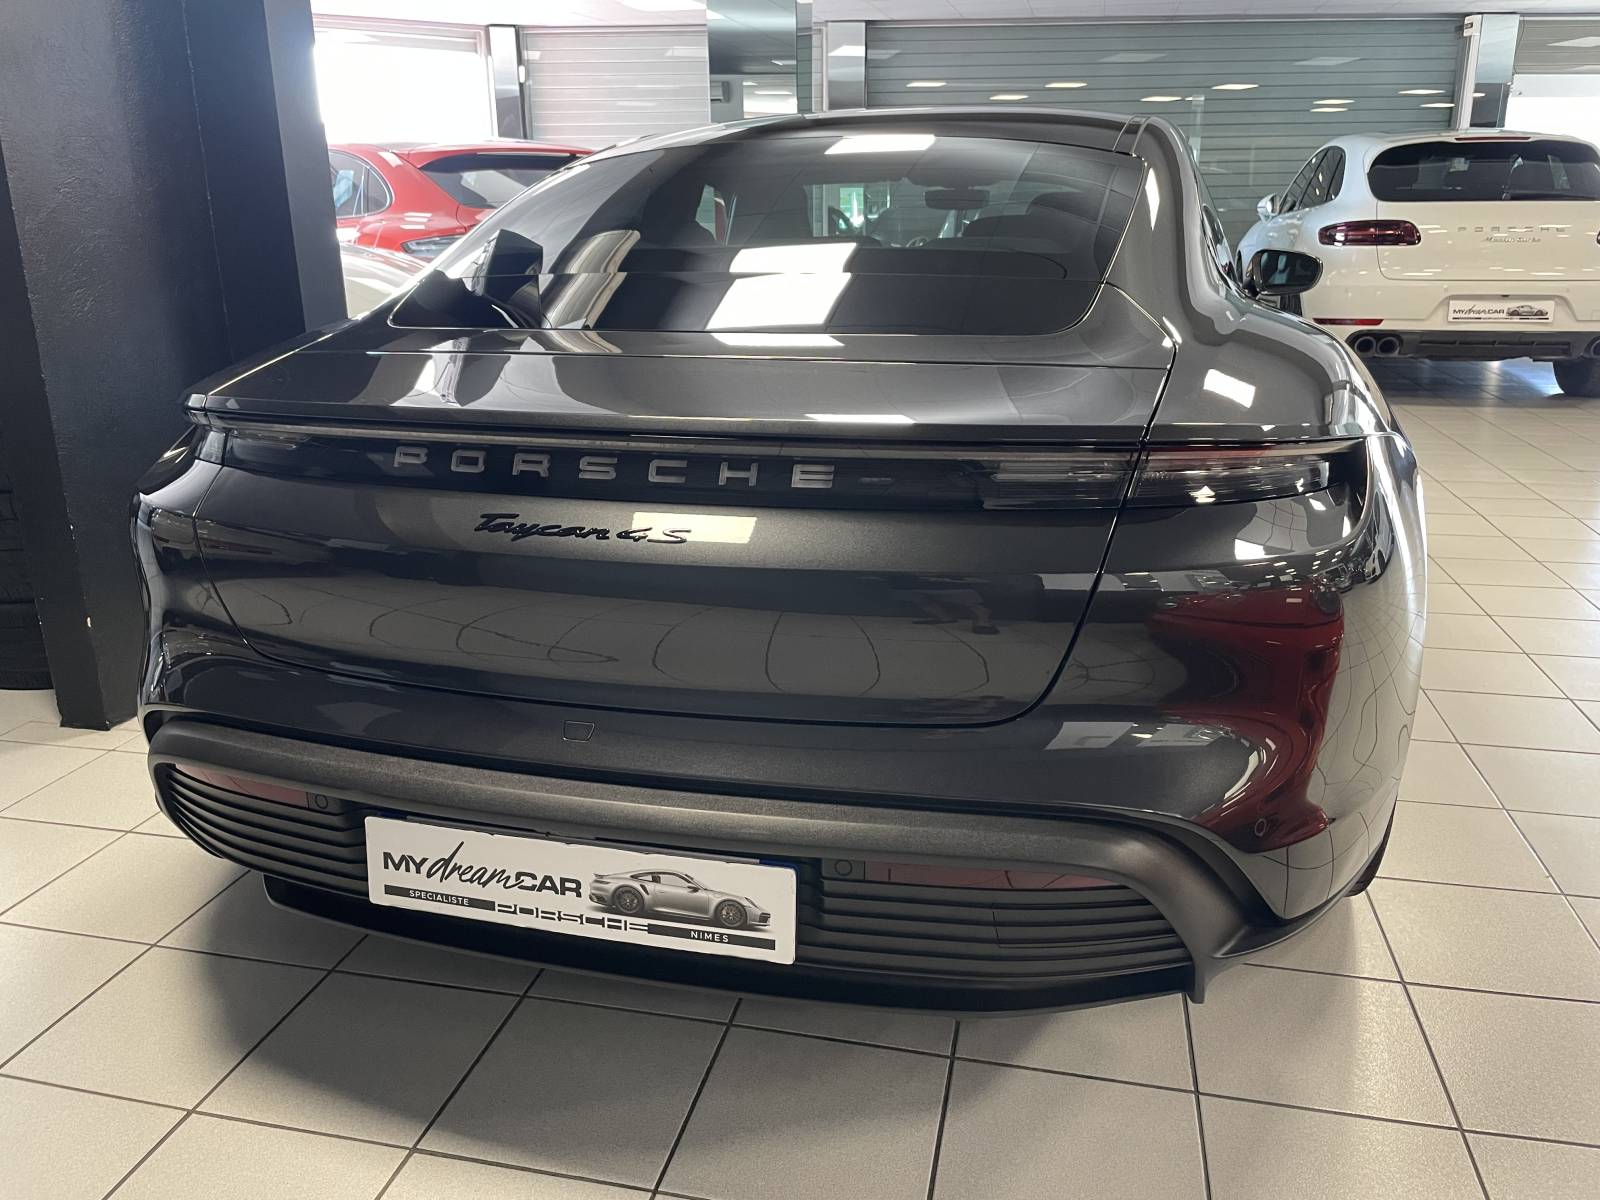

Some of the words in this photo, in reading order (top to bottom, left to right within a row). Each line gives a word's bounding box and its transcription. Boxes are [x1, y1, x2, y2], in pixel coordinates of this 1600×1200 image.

[393, 445, 835, 489] PORSCHE
[474, 513, 610, 542] Taycan
[409, 889, 470, 906] SPECIALISTE
[690, 930, 729, 943] NIMES
